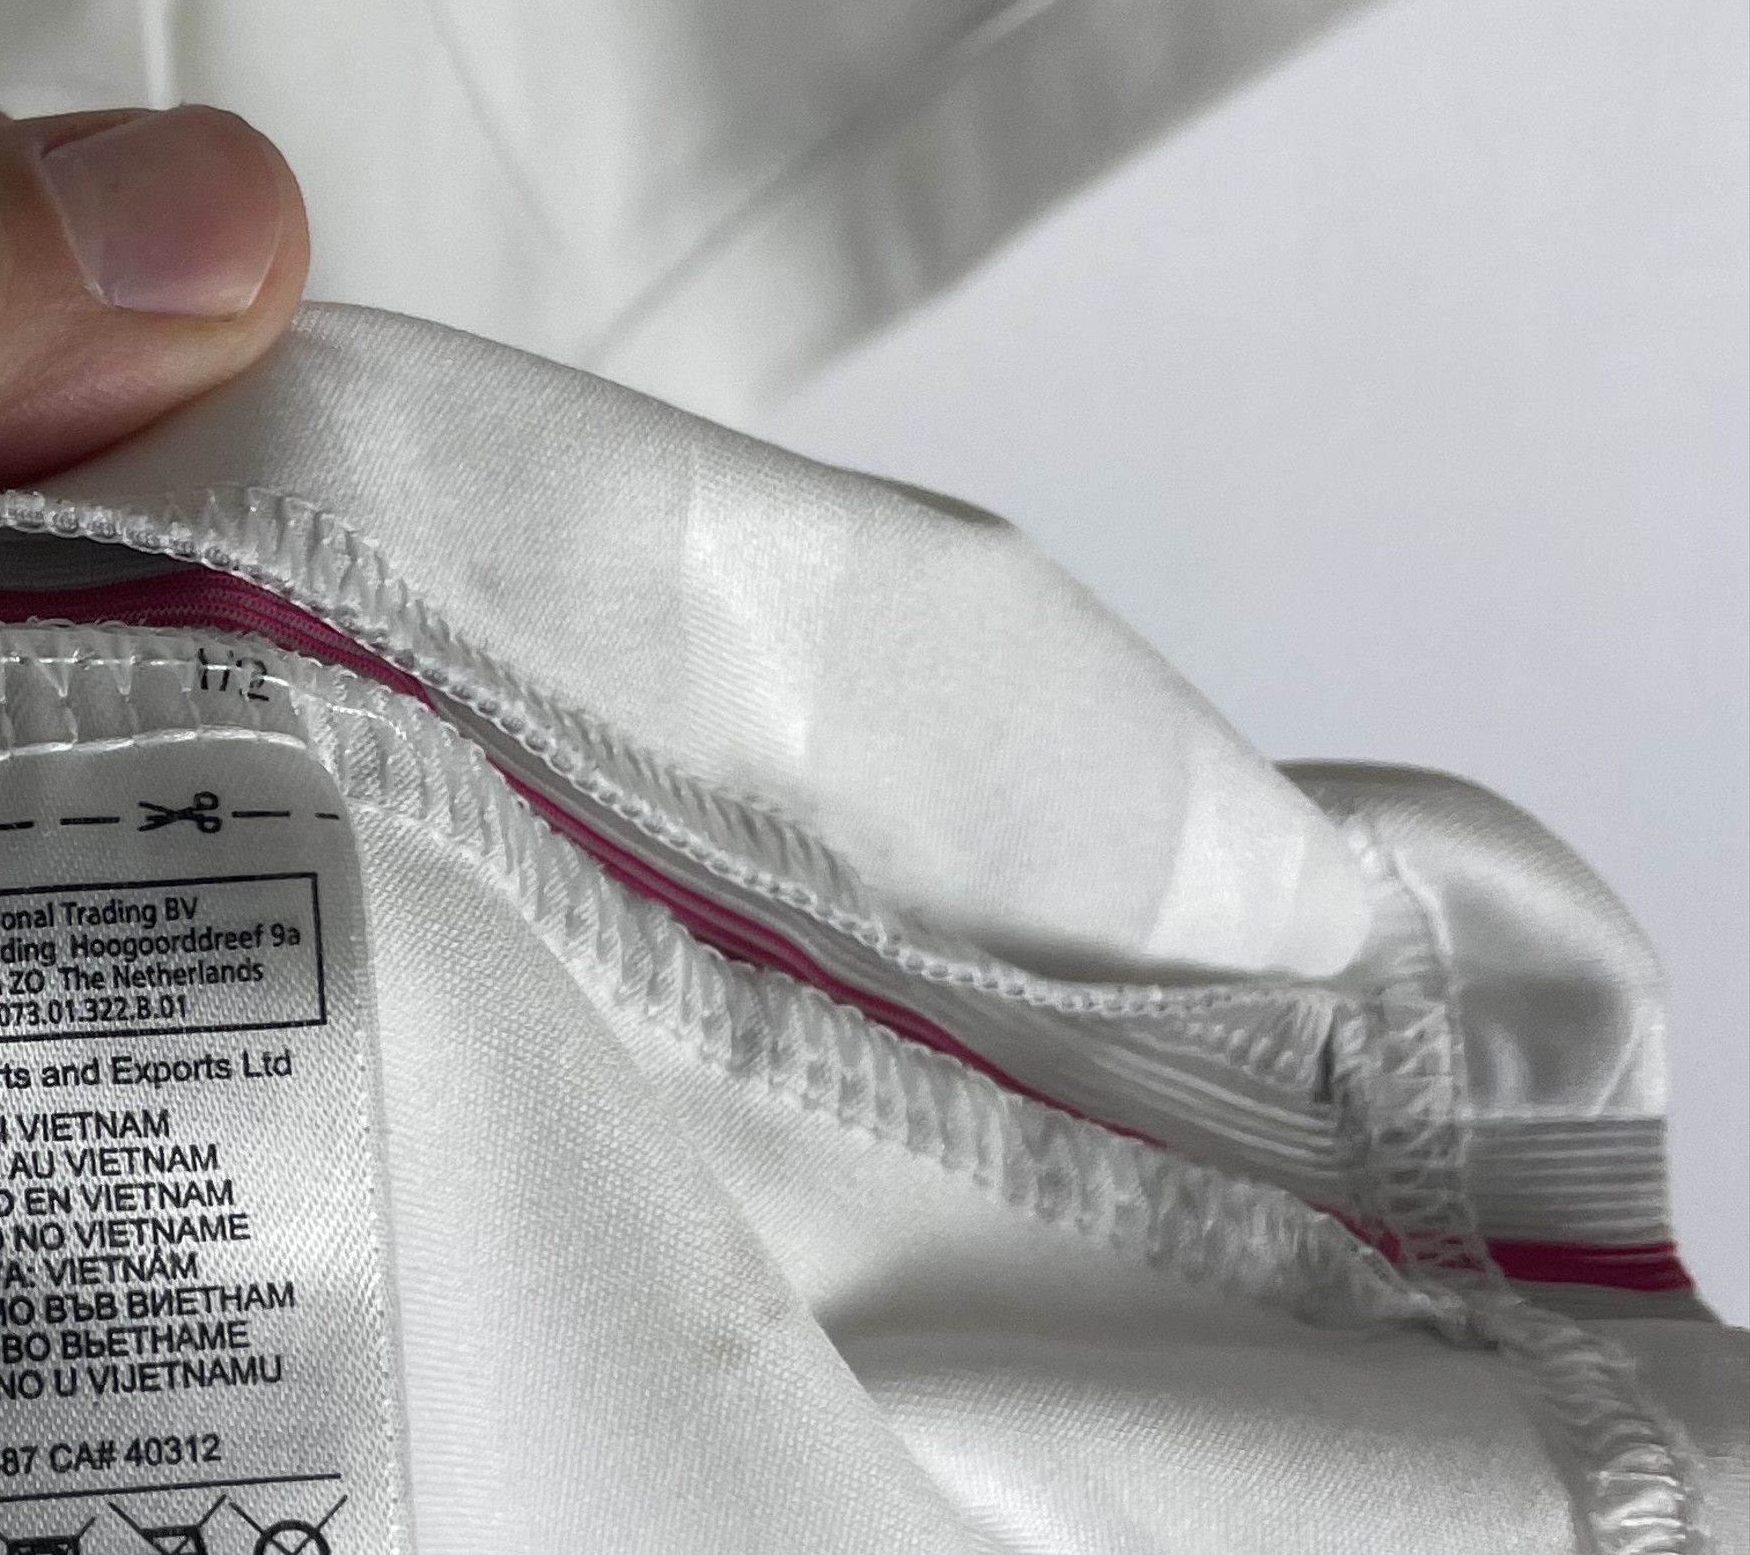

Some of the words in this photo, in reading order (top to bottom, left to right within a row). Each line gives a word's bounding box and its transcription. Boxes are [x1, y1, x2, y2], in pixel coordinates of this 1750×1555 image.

[61, 900, 156, 929] Trading
[165, 897, 197, 921] BV
[271, 924, 300, 947] 9a
[9, 969, 45, 995] ZO
[58, 966, 104, 991] The
[113, 958, 263, 989] Netherlands
[42, 1057, 99, 1087] and
[112, 1055, 231, 1089] Exports
[243, 1048, 293, 1078] Ltd
[17, 1109, 170, 1142] VIETNAM
[9, 1151, 54, 1180] AU
[65, 1144, 218, 1177] VIETNAM
[25, 1186, 72, 1216] EN
[81, 1179, 234, 1212] VIETNAM
[14, 1222, 65, 1251] NO
[74, 1214, 250, 1248] VIETNAME
[44, 1248, 197, 1286] VIETNÁM
[127, 1282, 294, 1319] ВИЕТНАМ
[3, 1332, 50, 1364] ВО
[62, 1321, 249, 1360] ВЬЕТНАМЕ
[55, 1367, 76, 1397] U
[88, 1355, 282, 1394] VIJETNAMU
[50, 1441, 116, 1473] CA#
[124, 1433, 221, 1466] 40312
